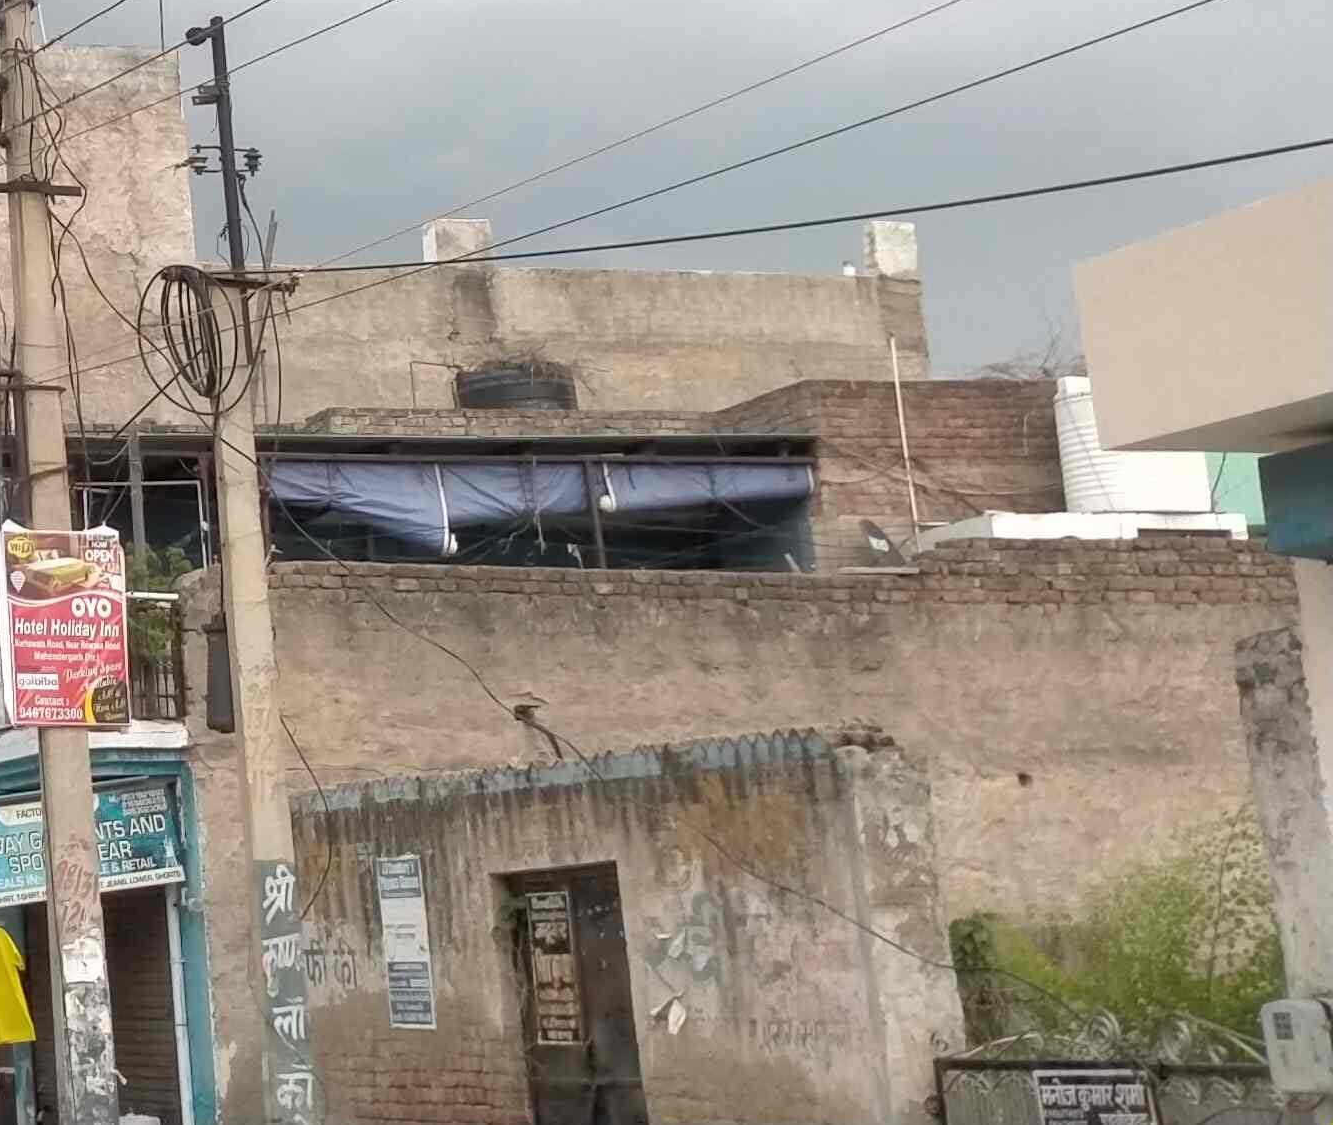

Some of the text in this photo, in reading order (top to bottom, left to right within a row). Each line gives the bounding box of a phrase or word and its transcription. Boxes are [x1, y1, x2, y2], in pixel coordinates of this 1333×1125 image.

[85, 549, 115, 563] OPEN
[71, 597, 112, 618] OYO
[14, 618, 120, 641] Hotel Holiday Inn
[130, 814, 166, 836] AND
[121, 856, 157, 871] RETAIL
[262, 863, 295, 924] श्री
